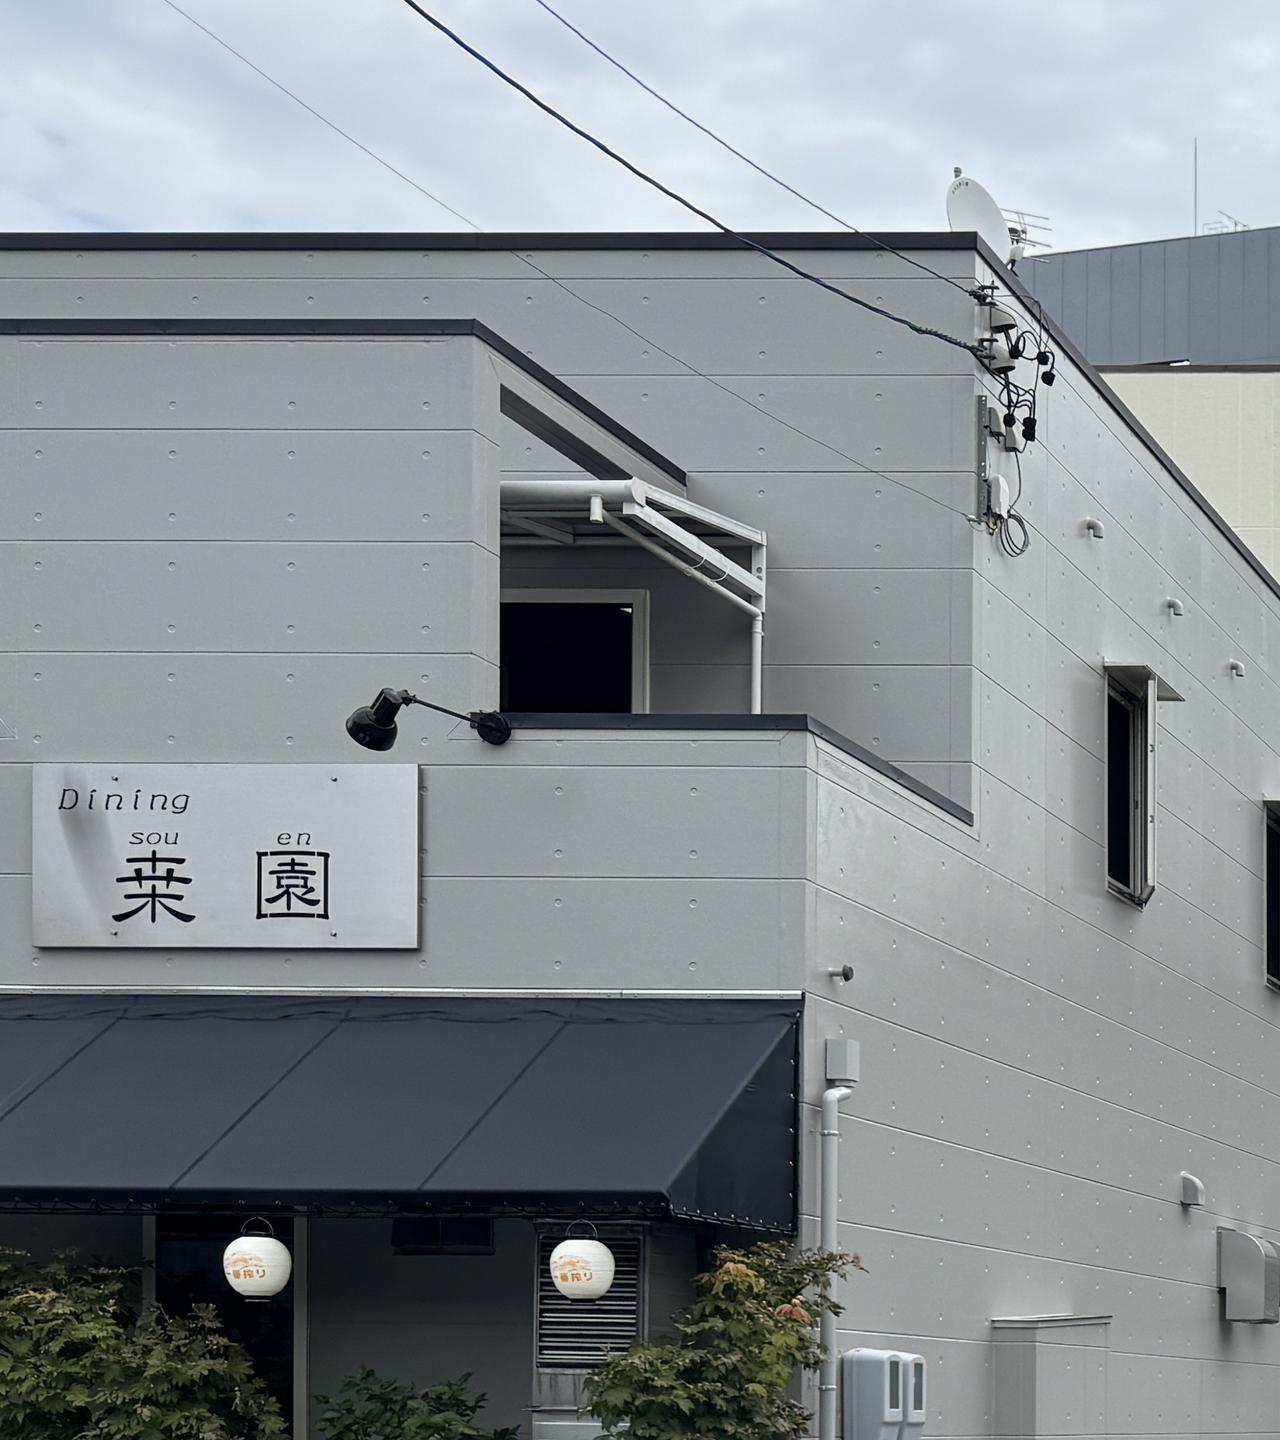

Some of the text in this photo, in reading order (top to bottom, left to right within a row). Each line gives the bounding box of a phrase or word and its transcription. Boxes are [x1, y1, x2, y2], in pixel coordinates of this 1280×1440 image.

[58, 787, 191, 815] Dining
[128, 830, 180, 846] sou
[276, 830, 312, 846] en
